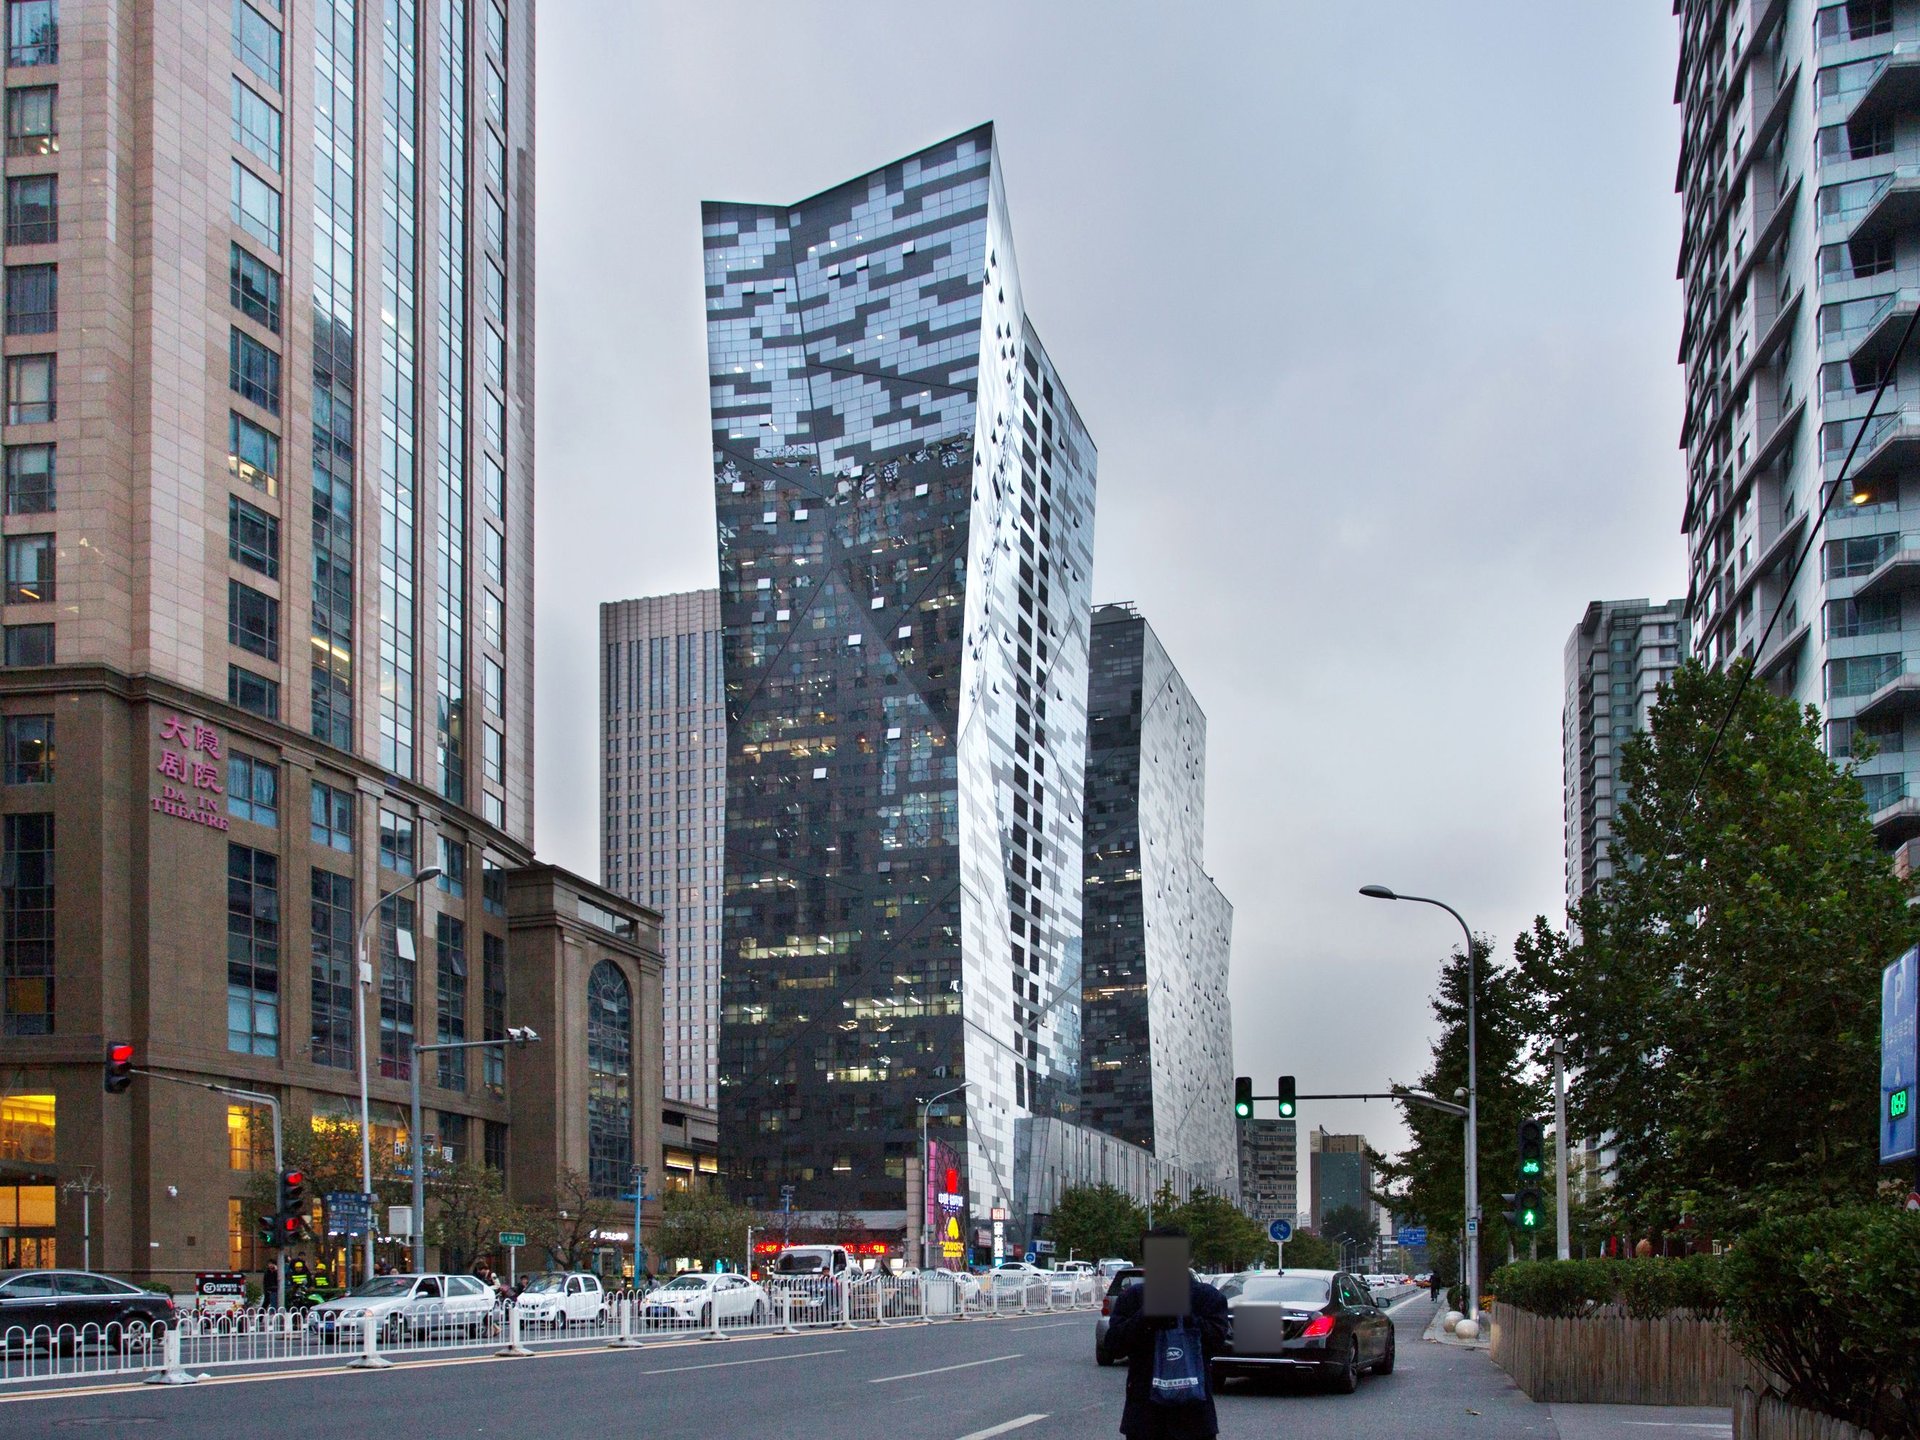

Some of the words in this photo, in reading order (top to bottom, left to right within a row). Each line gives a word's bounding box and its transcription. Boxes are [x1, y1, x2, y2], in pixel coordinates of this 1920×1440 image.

[158, 749, 223, 794] 剧院
[153, 797, 229, 831] THEATRE
[163, 785, 187, 803] DA
[197, 795, 219, 813] IN
[1895, 973, 1903, 1016] P
